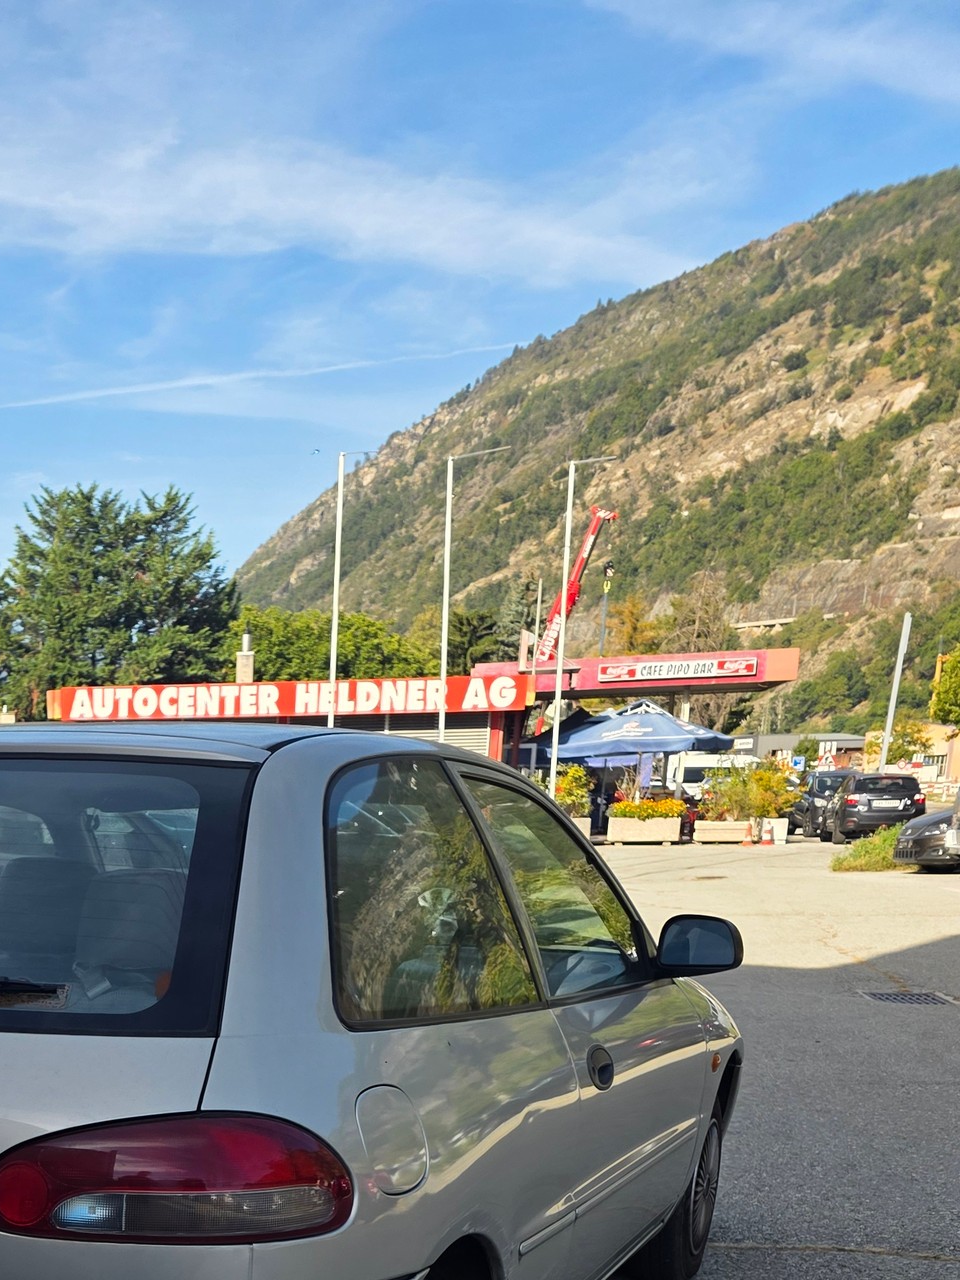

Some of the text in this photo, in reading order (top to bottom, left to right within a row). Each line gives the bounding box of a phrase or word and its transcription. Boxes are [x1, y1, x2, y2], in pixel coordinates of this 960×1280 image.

[640, 664, 664, 677] CAFE
[666, 663, 690, 676] PIPO
[693, 662, 714, 674] BAR
[69, 676, 517, 719] AUTOCENTER HELDNER AG
